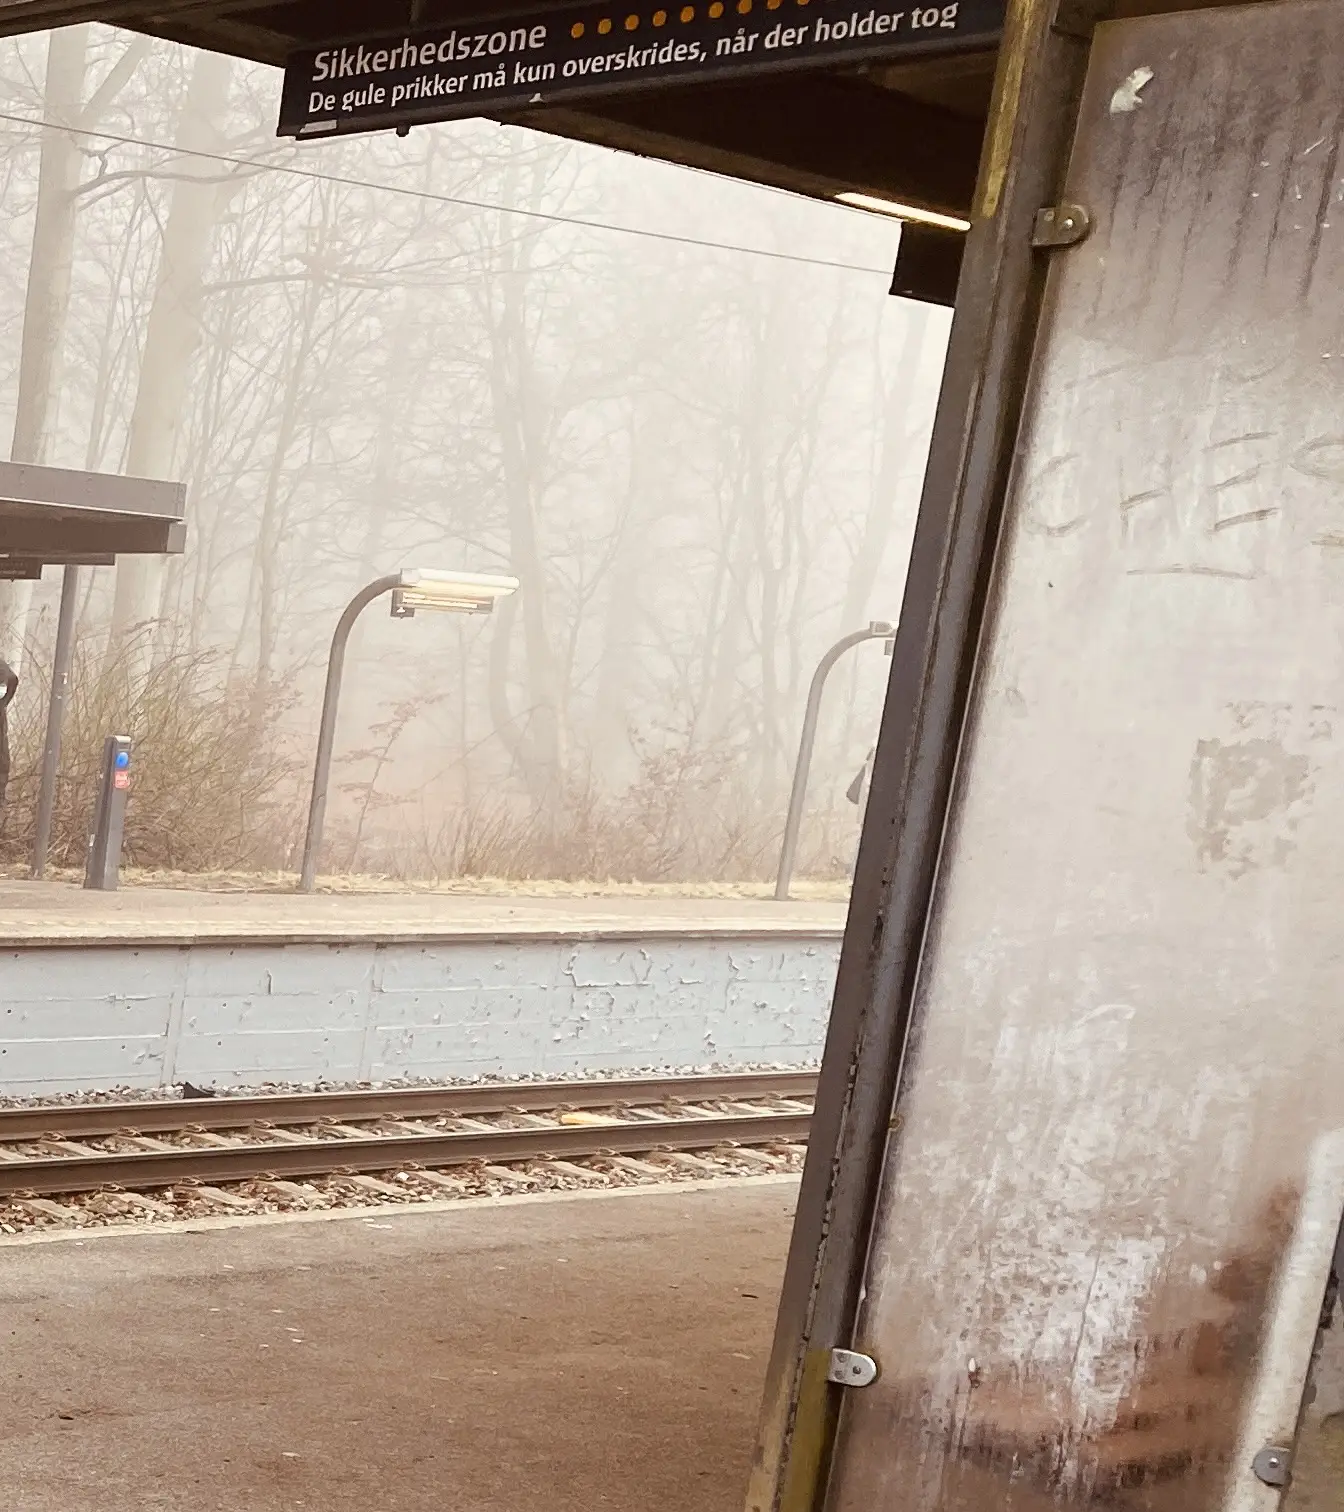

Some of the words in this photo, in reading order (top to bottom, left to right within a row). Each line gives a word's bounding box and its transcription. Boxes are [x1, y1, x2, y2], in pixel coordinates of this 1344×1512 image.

[308, 91, 336, 113] De
[341, 83, 386, 112] gule
[390, 74, 469, 107] prikker
[472, 62, 506, 90] må
[513, 61, 556, 85] kun
[562, 38, 707, 78] overskrides,
[715, 27, 760, 57] når
[764, 22, 809, 49] der
[814, 9, 905, 42] holder
[912, 2, 960, 29] tog
[311, 24, 548, 82] Sikkerhedszone
